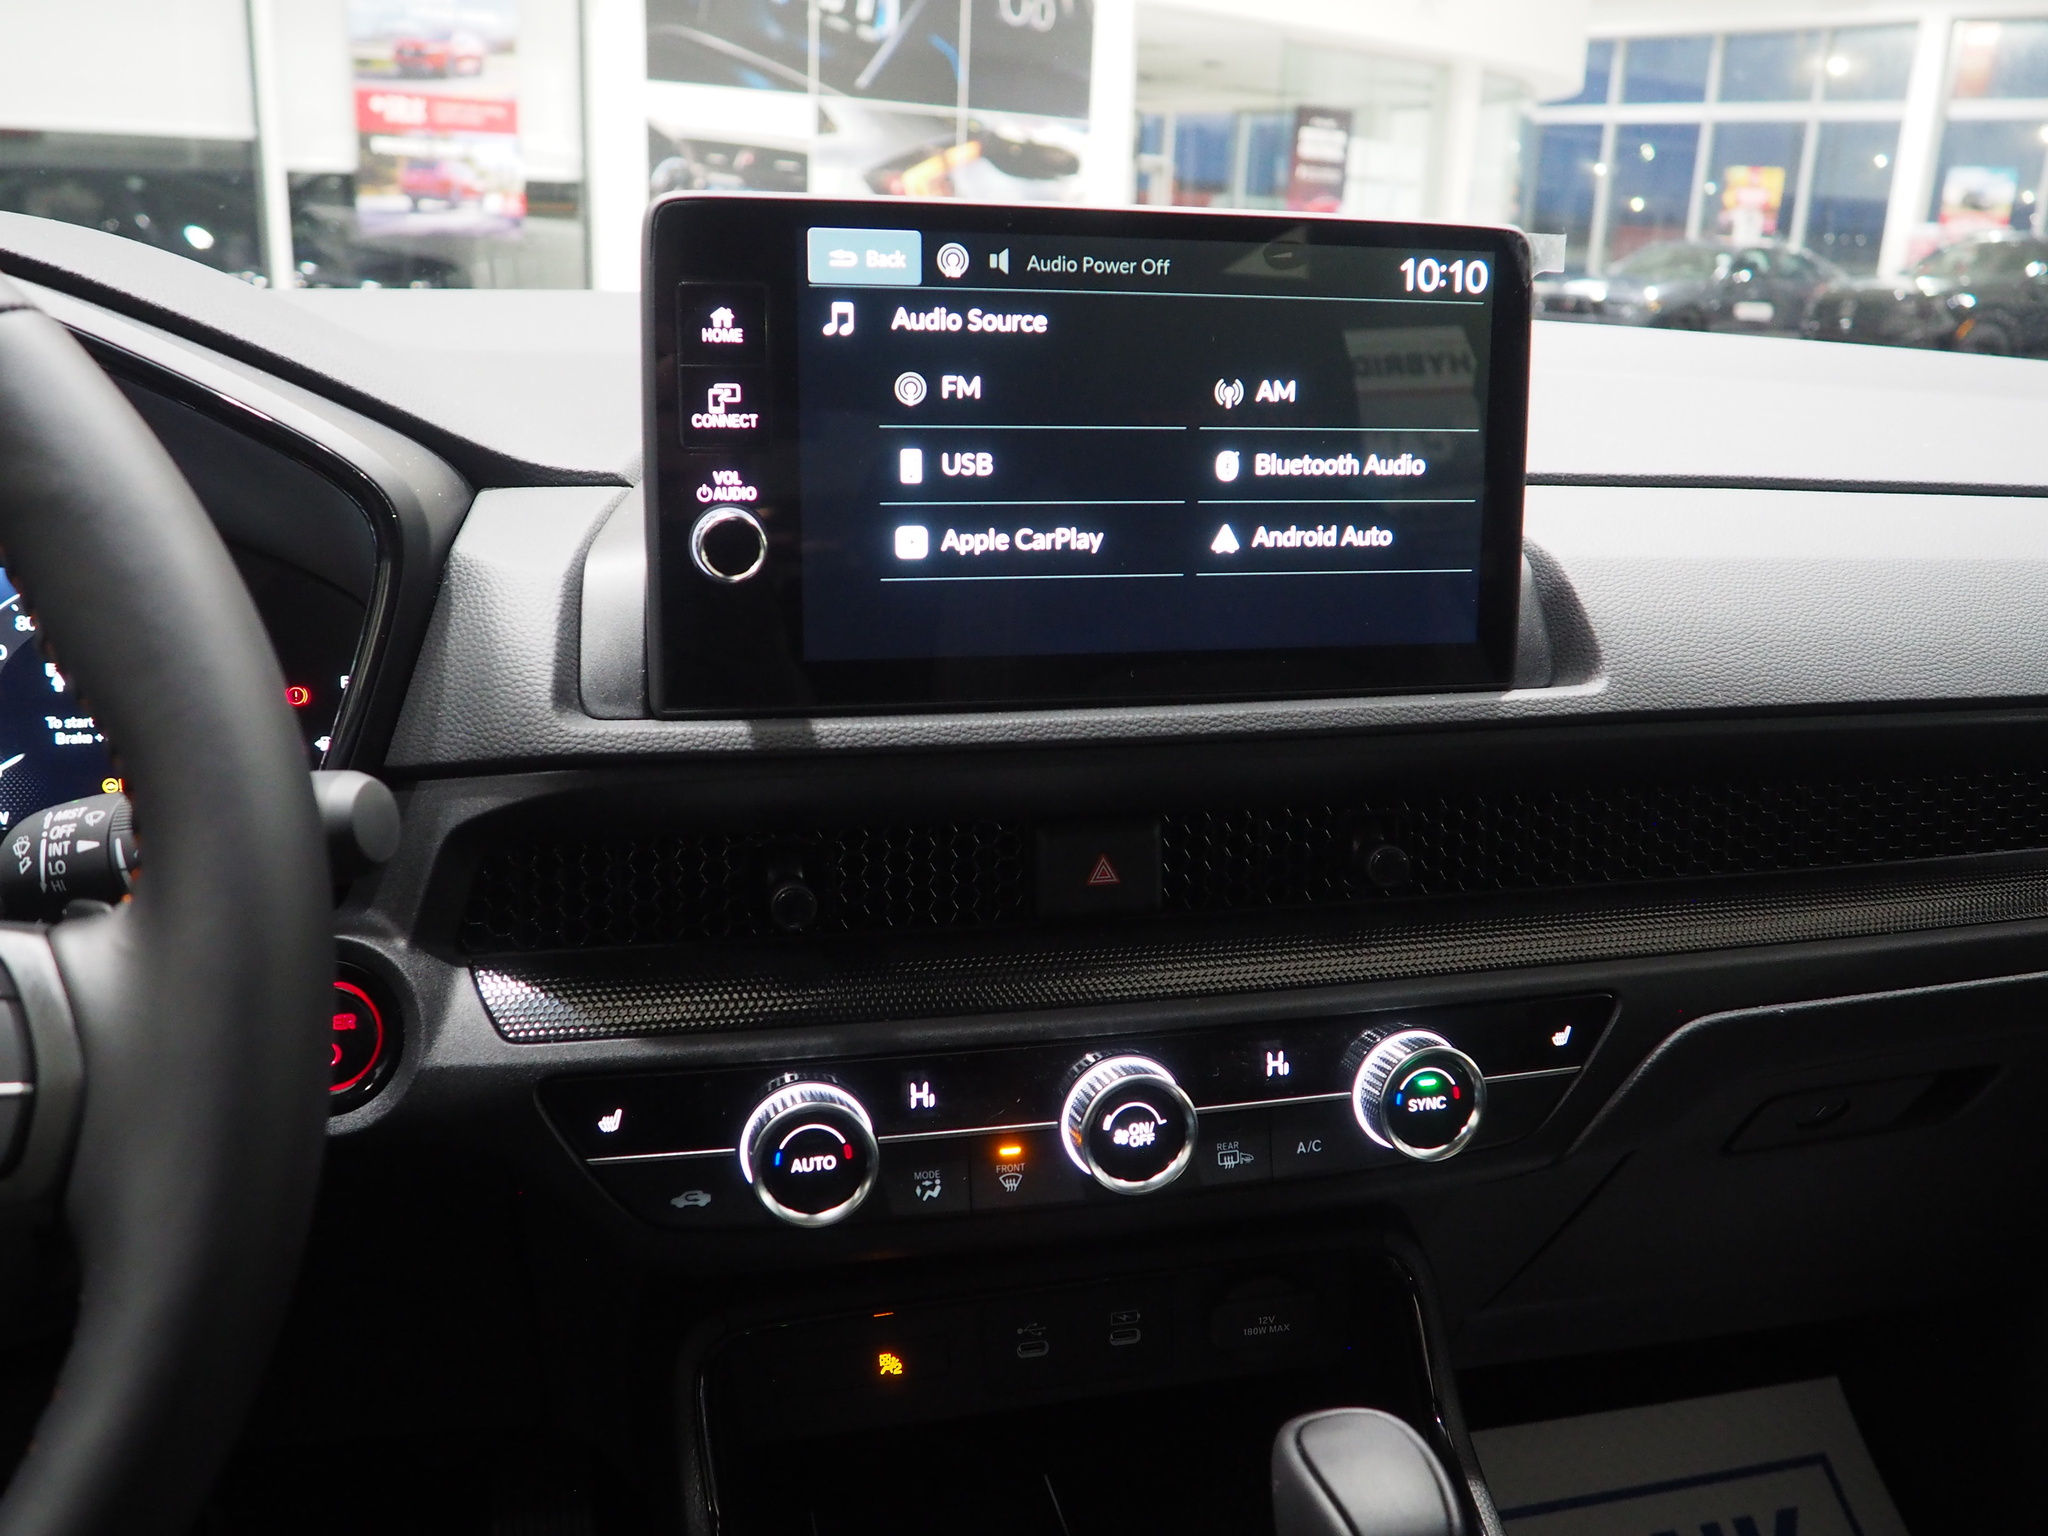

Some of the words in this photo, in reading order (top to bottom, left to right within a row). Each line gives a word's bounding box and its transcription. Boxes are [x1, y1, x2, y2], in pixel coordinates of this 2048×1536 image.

[867, 250, 906, 268] Back
[1027, 255, 1077, 273] Audio
[1083, 257, 1137, 274] Power
[1141, 259, 1171, 275] Off
[1399, 257, 1490, 294] 10:10
[891, 307, 963, 332] Audio
[966, 308, 1048, 333] Source
[702, 327, 744, 343] HOME
[941, 375, 982, 399] FM
[1255, 380, 1296, 403] AM
[691, 413, 759, 429] CONNECT
[942, 452, 994, 477] USB
[1255, 453, 1360, 477] Bluetooth
[1363, 453, 1427, 477] Audio
[712, 470, 743, 486] VOL
[713, 486, 758, 501] AUDIO
[940, 528, 1010, 556] Apple
[1014, 526, 1105, 554] CarPlay
[1251, 524, 1335, 548] Android
[1340, 525, 1394, 548] Auto
[45, 716, 62, 729] To
[64, 716, 95, 729] start
[55, 732, 93, 745] Brake
[53, 807, 88, 822] MIST
[50, 823, 77, 840] OFF
[48, 841, 71, 857] INT
[48, 860, 67, 875] LO
[51, 879, 67, 892] HI
[1407, 1096, 1447, 1113] SYNC
[1128, 1121, 1156, 1135] ON/
[1129, 1133, 1156, 1148] OFF
[1216, 1142, 1239, 1153] REAR
[1296, 1139, 1322, 1154] A/C
[791, 1155, 837, 1174] AUTO
[996, 1163, 1026, 1174] FRONT
[914, 1170, 941, 1181] MODE
[1258, 1315, 1276, 1325] 12V
[1243, 1326, 1267, 1336] 180W
[1269, 1323, 1290, 1333] MAX
